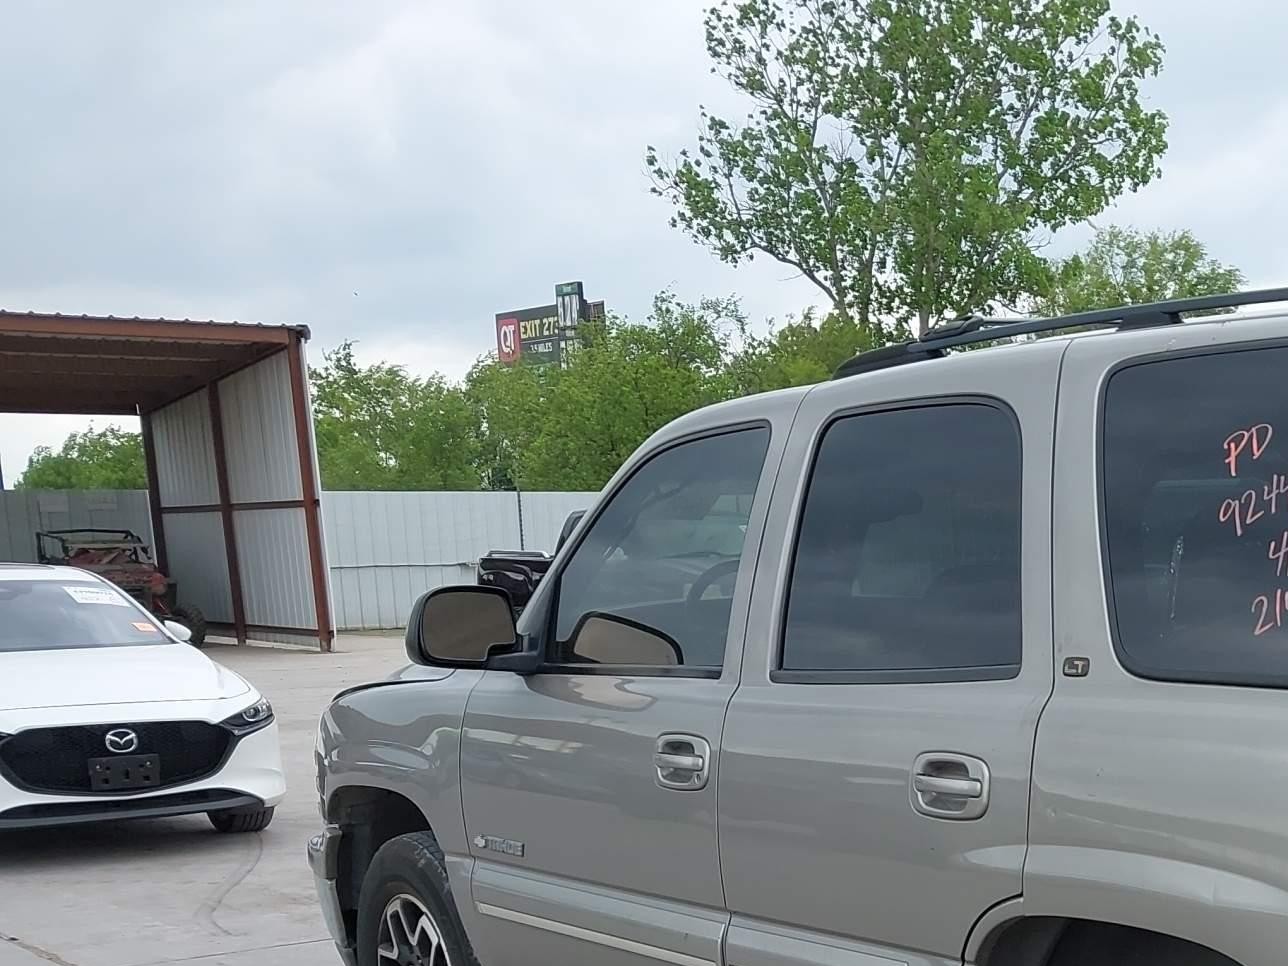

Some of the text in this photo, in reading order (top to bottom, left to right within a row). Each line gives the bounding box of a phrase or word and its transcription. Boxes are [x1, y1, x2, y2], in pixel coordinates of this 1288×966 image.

[500, 325, 515, 355] QT
[520, 319, 541, 339] EXIT
[1223, 423, 1273, 477] PD
[1064, 659, 1088, 675] LT
